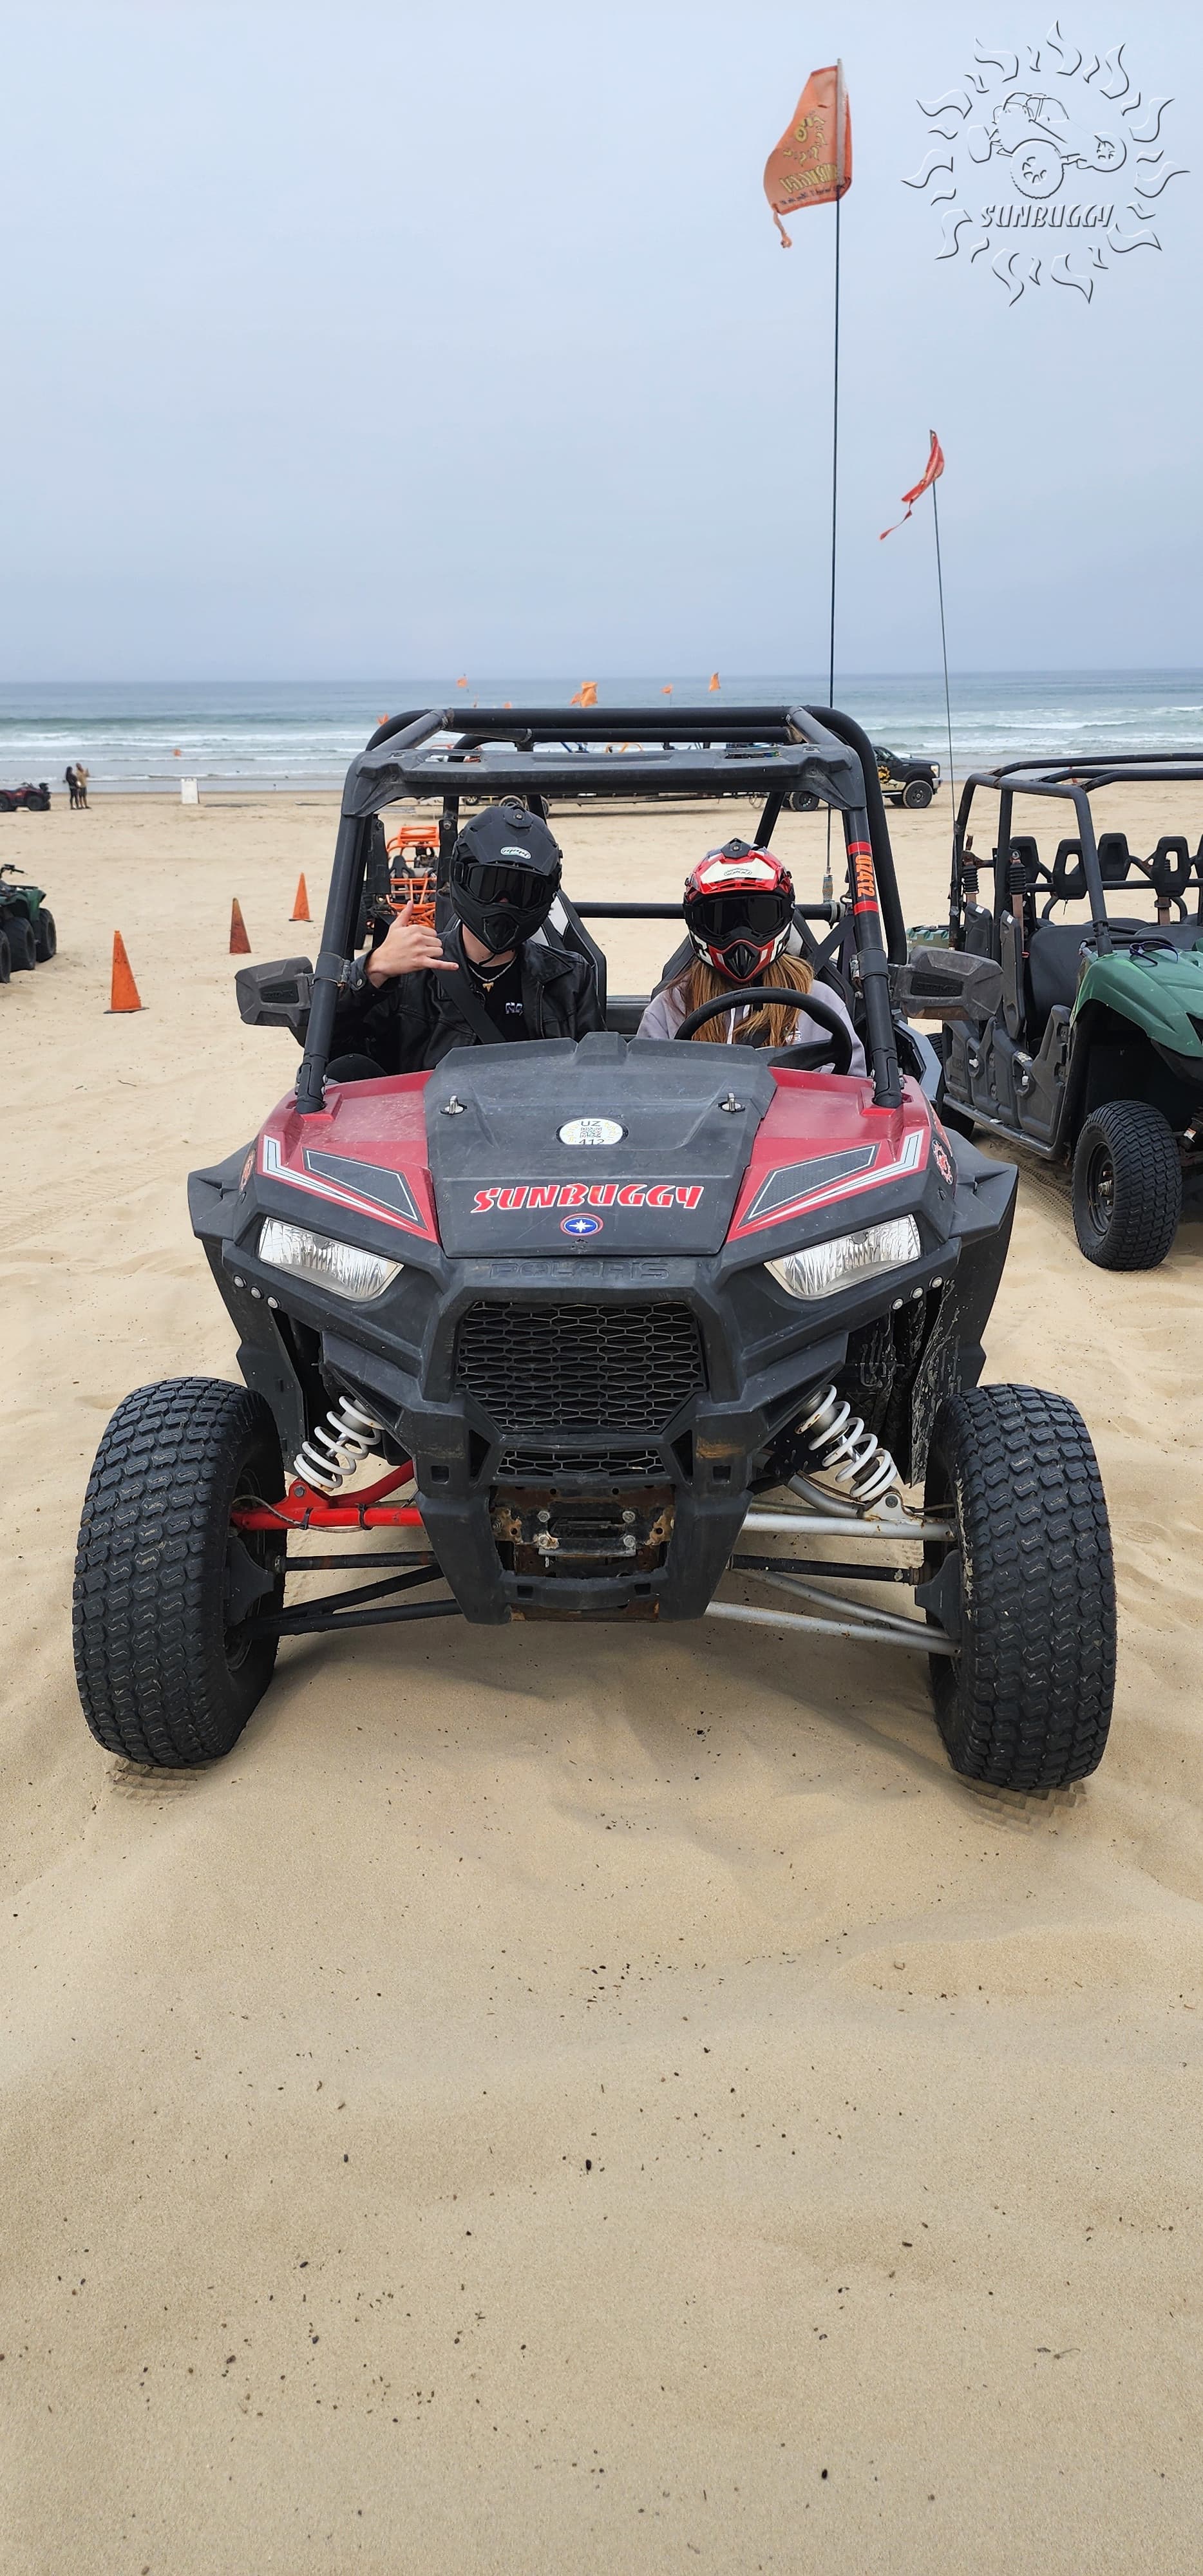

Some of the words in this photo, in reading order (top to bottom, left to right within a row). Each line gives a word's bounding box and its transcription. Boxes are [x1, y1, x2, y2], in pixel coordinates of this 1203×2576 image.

[855, 854, 875, 898] UZ412
[471, 1183, 705, 1213] SUNBUGGY
[489, 1260, 670, 1281] POLARIS
